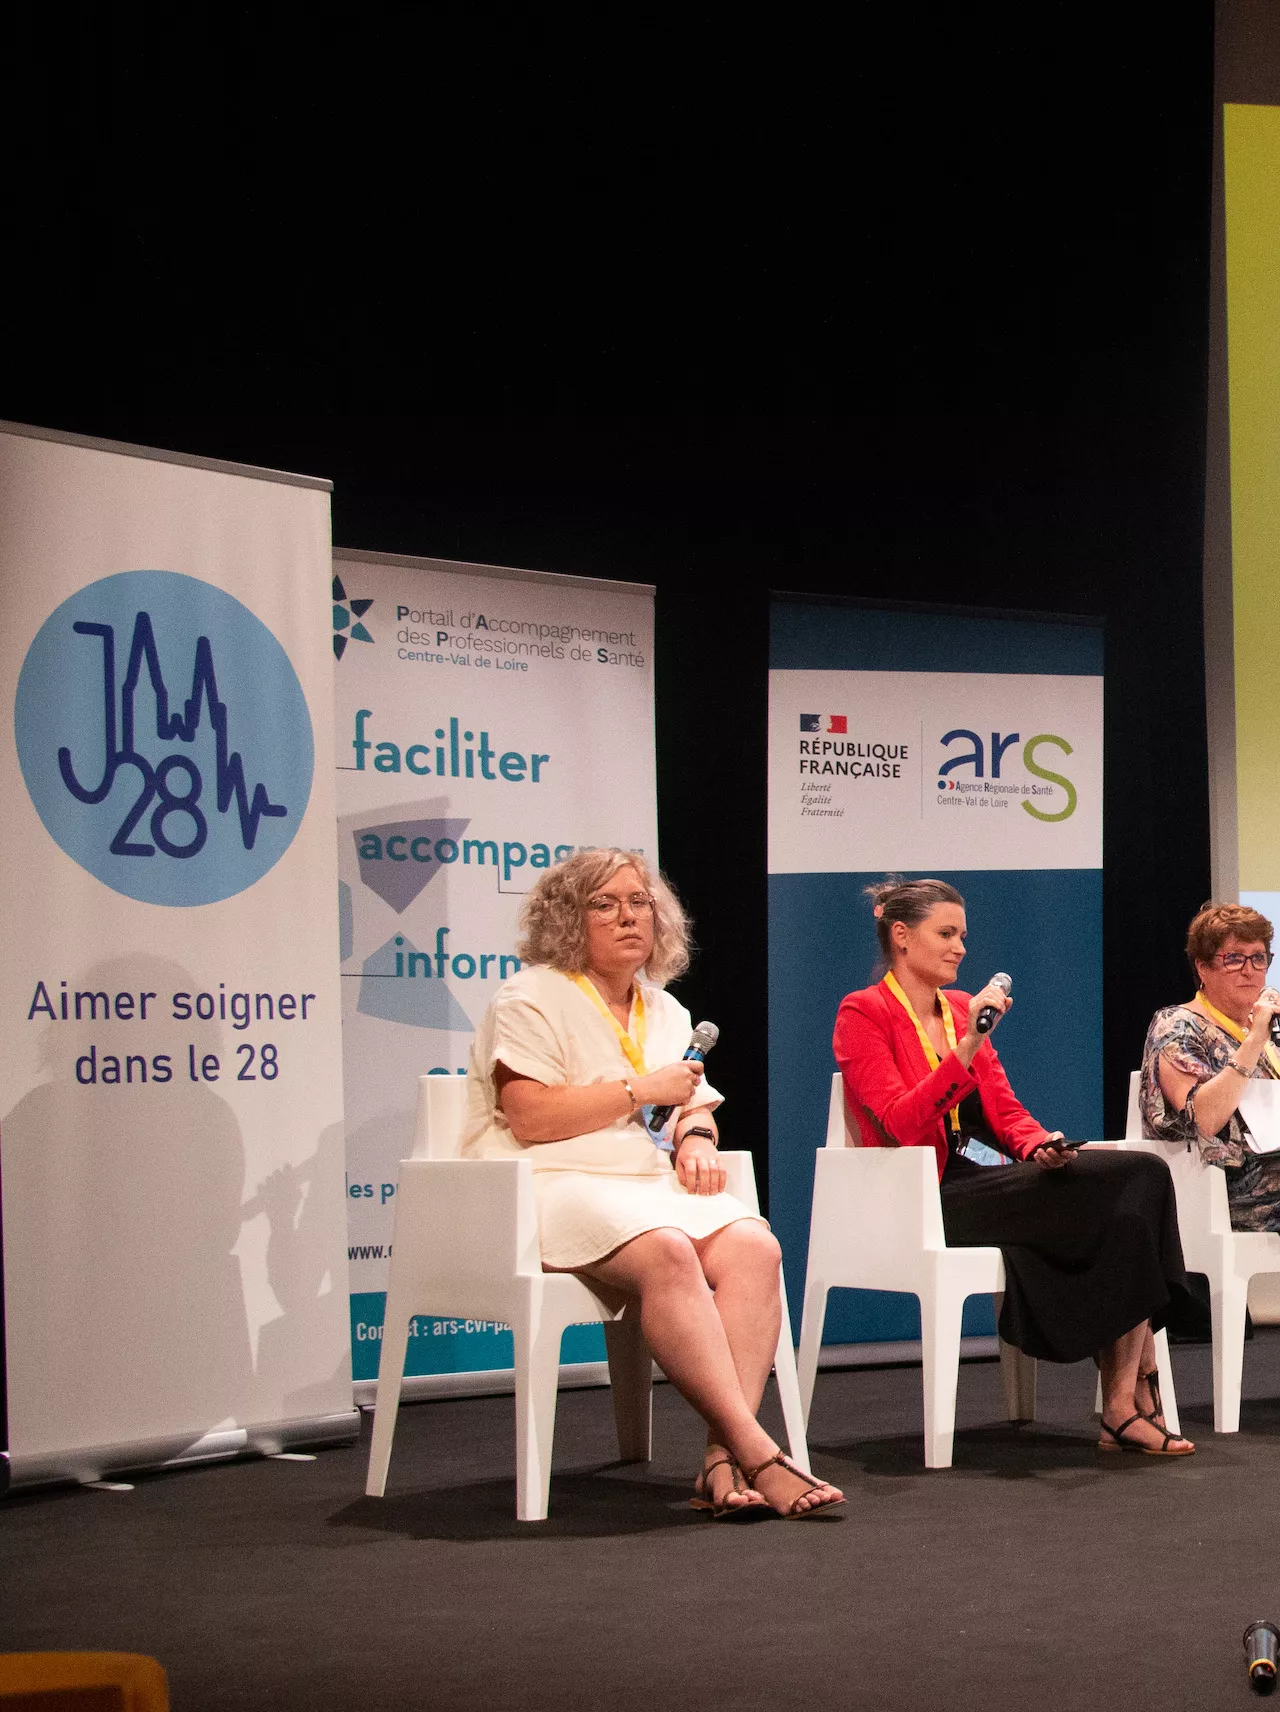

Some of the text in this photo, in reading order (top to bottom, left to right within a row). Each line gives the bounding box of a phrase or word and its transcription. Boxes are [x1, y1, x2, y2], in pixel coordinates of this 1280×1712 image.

[396, 605, 638, 648] Portail d'Accompagnement
[397, 627, 646, 668] des Professionnels de Santé
[397, 648, 529, 672] Centre-Val de Loire
[352, 709, 549, 782] faciliter
[800, 737, 908, 761] RÉPUBLIQUE
[800, 760, 901, 779] FRANÇAISE
[938, 729, 1077, 822] ars
[801, 782, 832, 792] Liberté
[955, 781, 1054, 796] Agence Régionale de Santé
[801, 793, 832, 806] Égalité
[937, 795, 1009, 808] Centre-Val de Loire
[801, 807, 845, 817] Fraternité
[28, 981, 315, 1030] Aimer soigner
[76, 1044, 278, 1084] dans le 28
